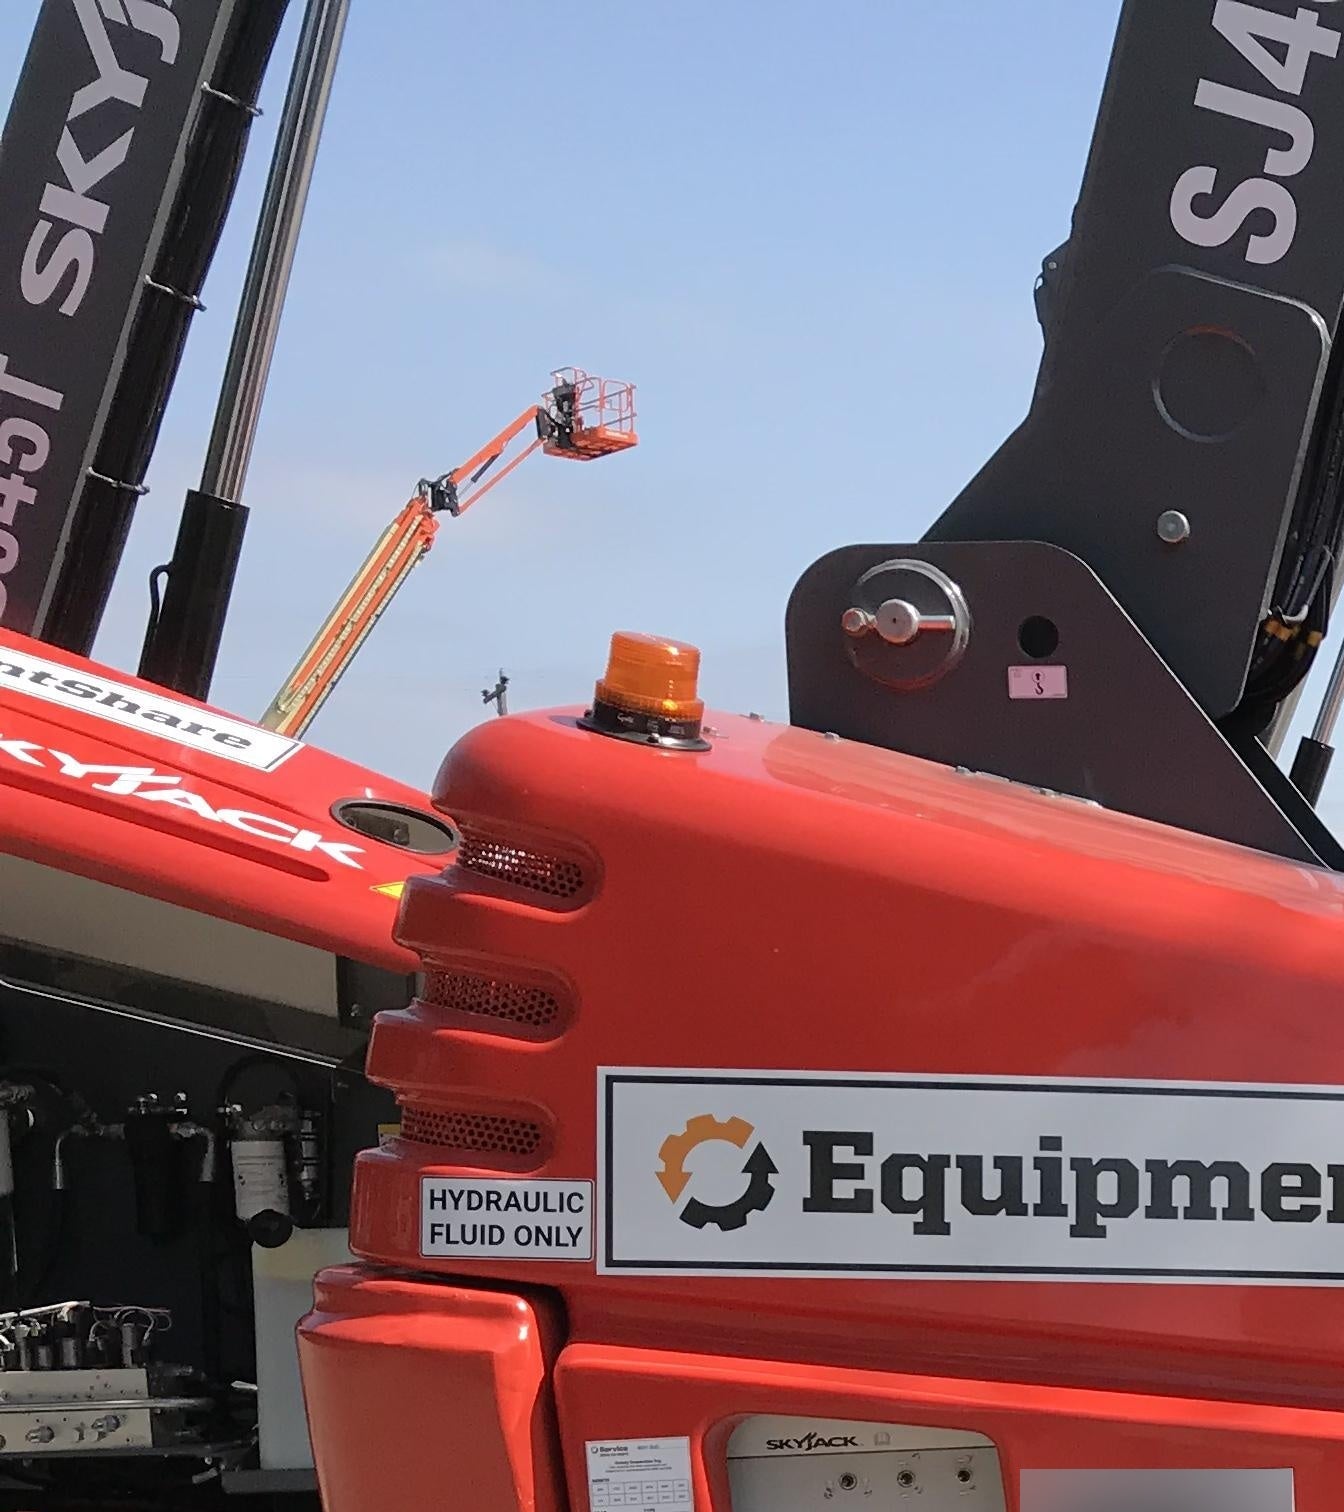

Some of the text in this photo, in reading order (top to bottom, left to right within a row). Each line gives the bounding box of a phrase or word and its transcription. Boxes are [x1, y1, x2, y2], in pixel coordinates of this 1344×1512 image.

[1170, 0, 1342, 264] SJ4
[429, 1189, 585, 1213] HYDRAULIC
[430, 1223, 583, 1247] FLUID ONLY
[766, 1432, 859, 1451] SKYJACK
